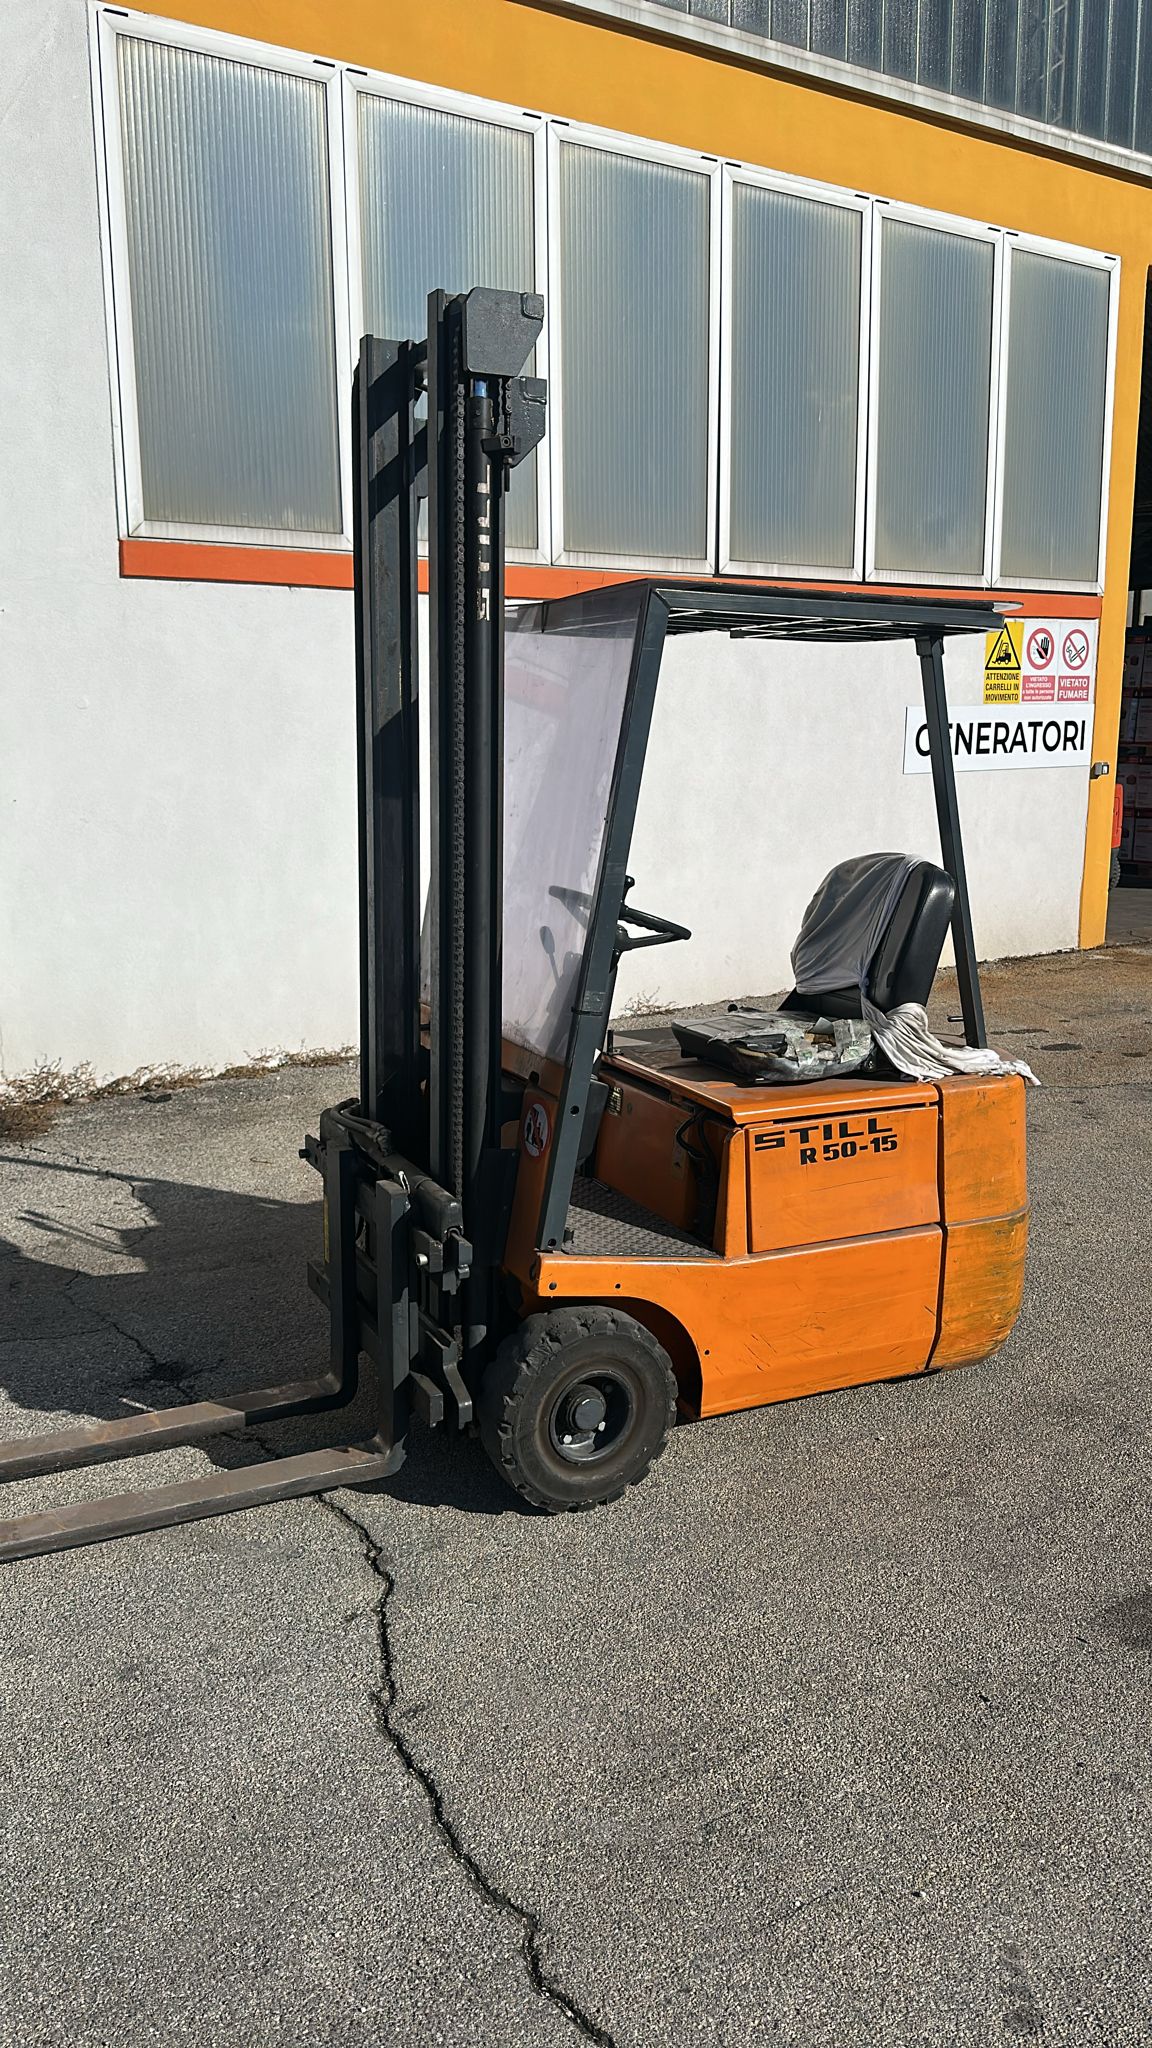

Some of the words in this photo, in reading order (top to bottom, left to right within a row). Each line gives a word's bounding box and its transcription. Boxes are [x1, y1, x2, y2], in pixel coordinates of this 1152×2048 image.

[985, 672, 1020, 681] ATTENZIONE
[985, 683, 1013, 691] CARRELLI
[1013, 682, 1019, 690] IN
[1060, 678, 1088, 687] VIETATO
[985, 693, 1019, 702] MOVIMENTO
[1059, 690, 1088, 699] FUMARE
[915, 720, 1086, 757] GNERATORI
[754, 1117, 893, 1152] STILL
[799, 1147, 818, 1166] R
[823, 1134, 898, 1162] 50-15
